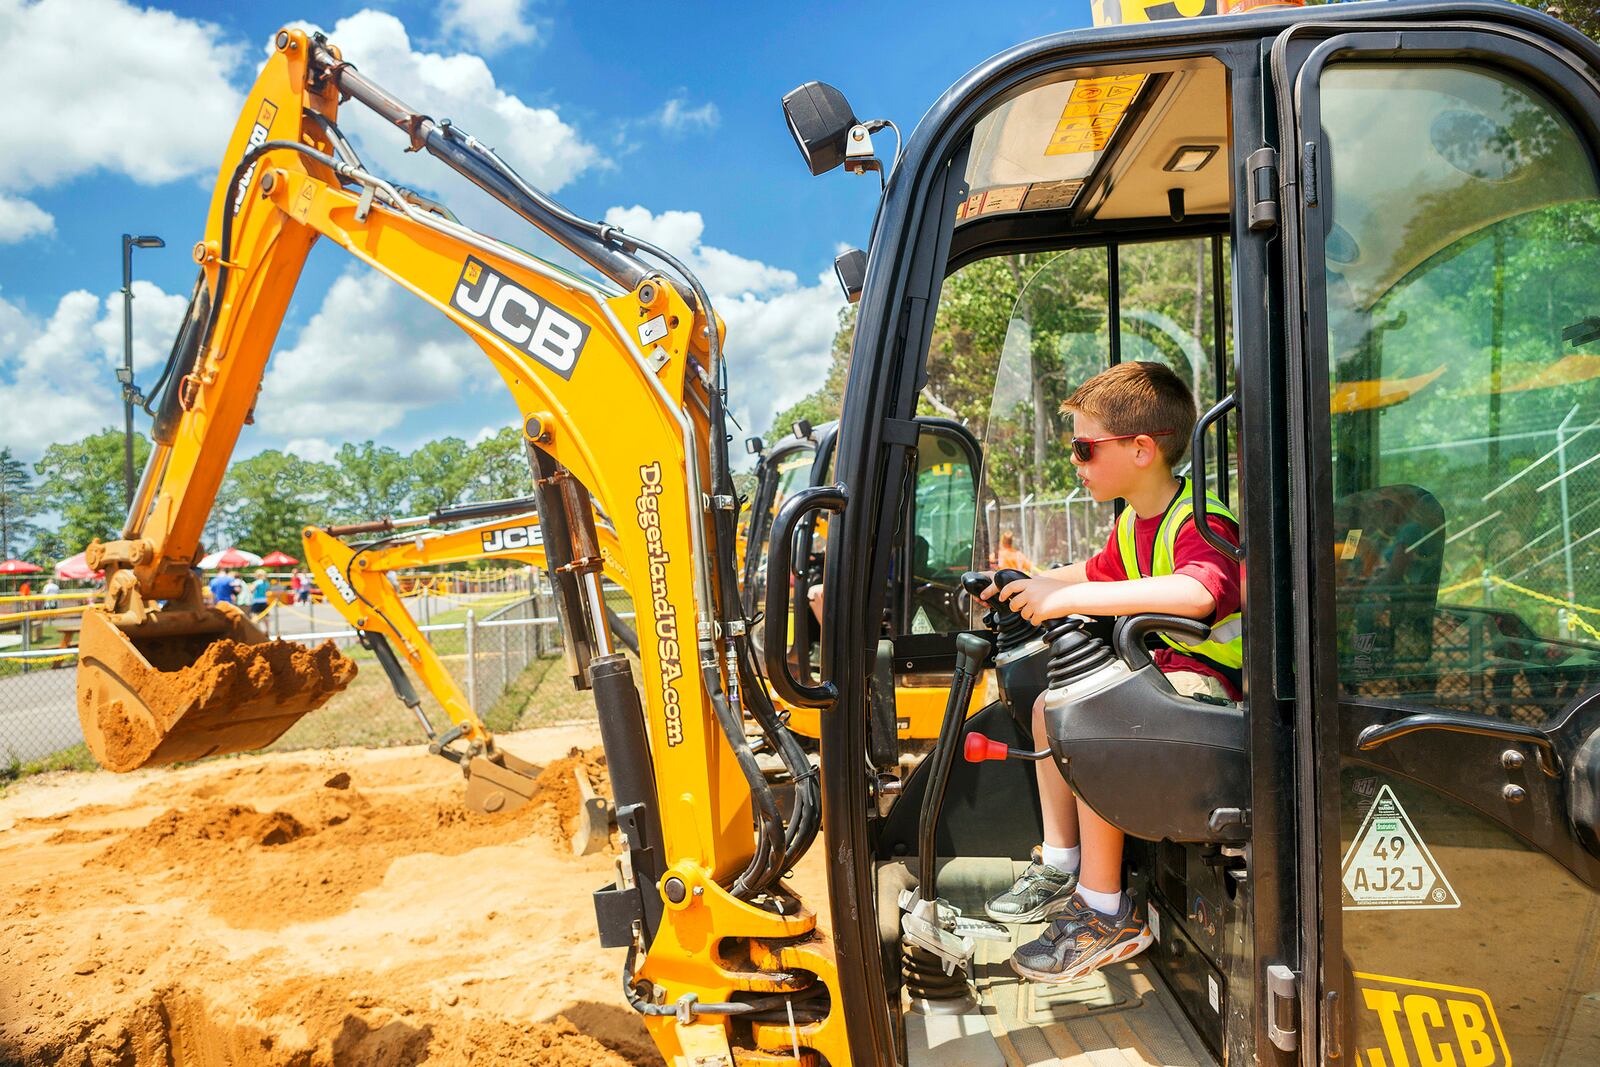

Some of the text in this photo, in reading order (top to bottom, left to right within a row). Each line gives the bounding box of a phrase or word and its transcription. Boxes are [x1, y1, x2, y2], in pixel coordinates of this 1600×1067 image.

[455, 272, 583, 372] JCB
[636, 461, 684, 747] DiggerlandUSA.com
[1353, 866, 1424, 892] AJ2J
[1373, 836, 1405, 861] 49
[1355, 988, 1496, 1067] JCB
